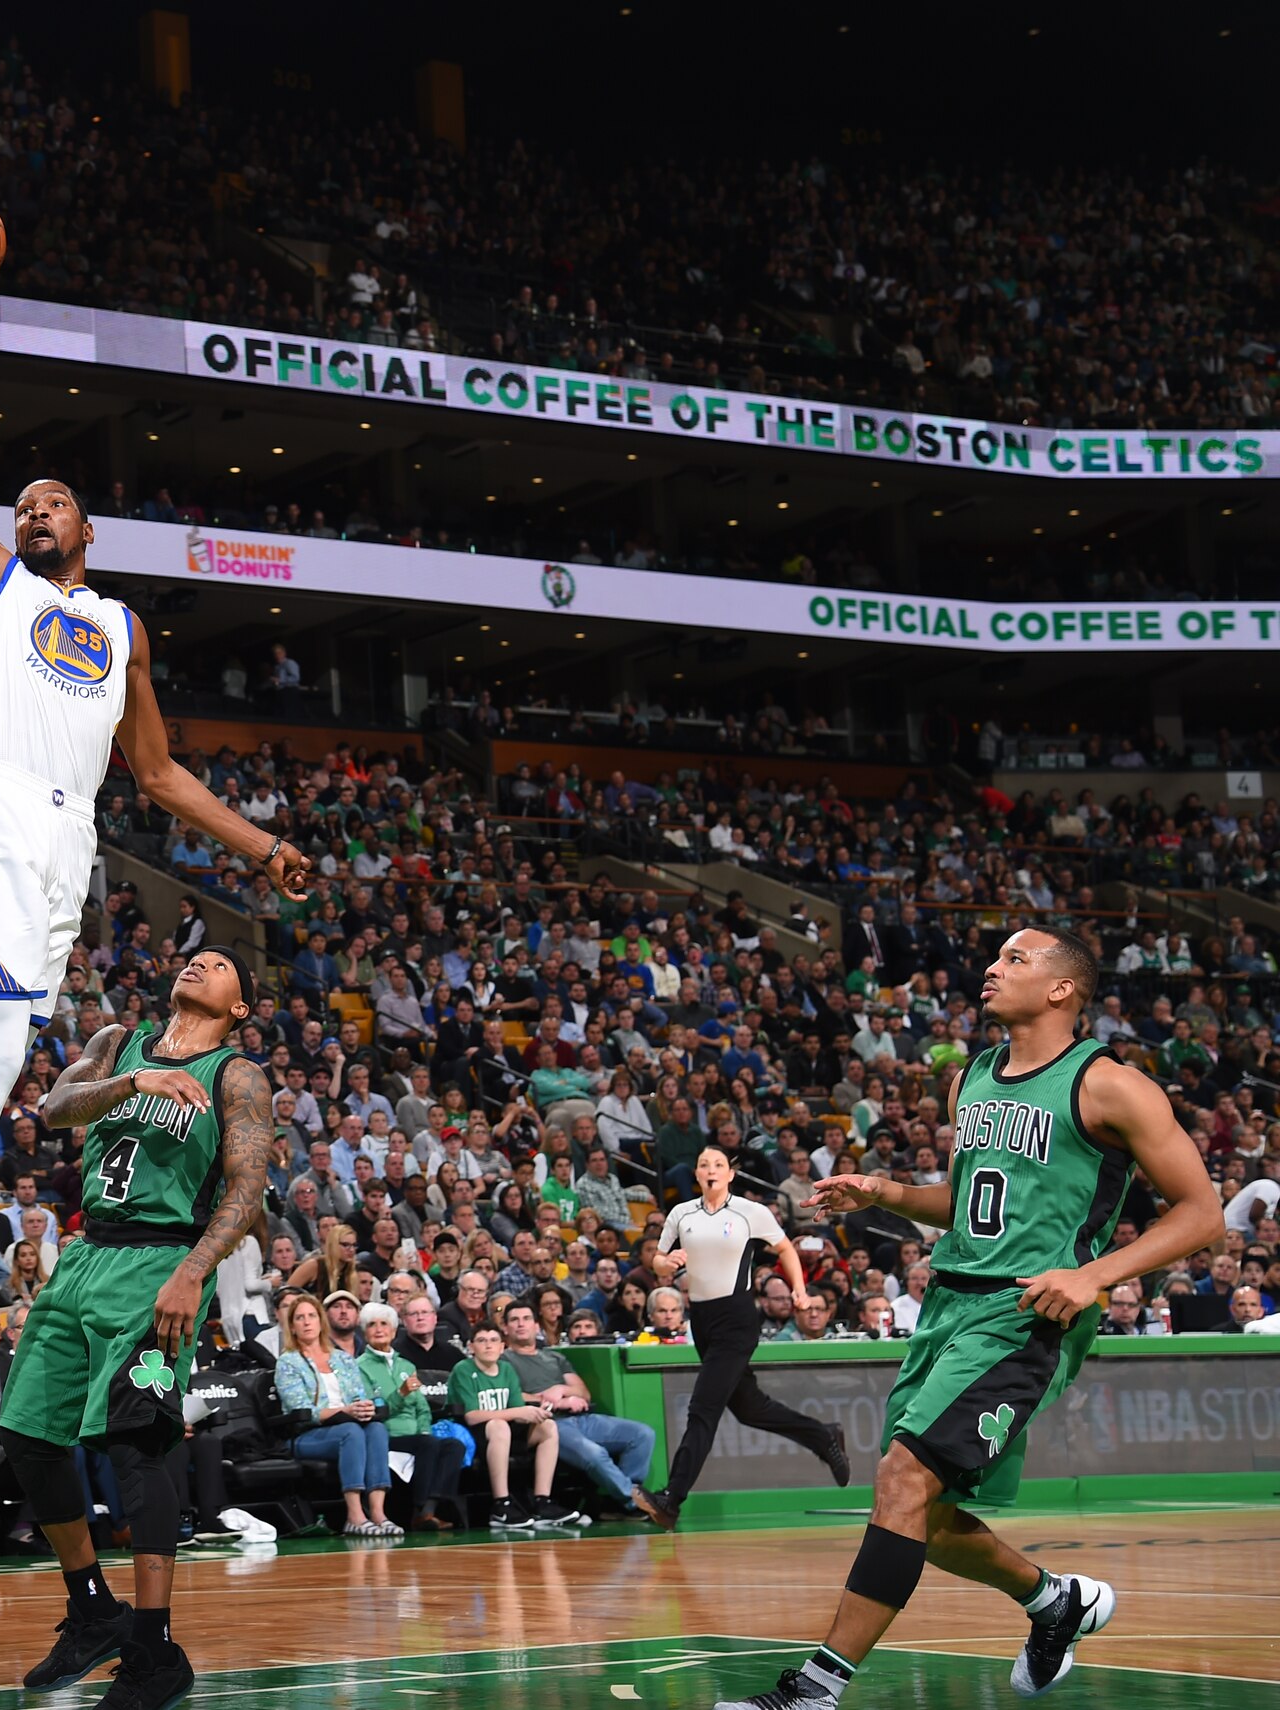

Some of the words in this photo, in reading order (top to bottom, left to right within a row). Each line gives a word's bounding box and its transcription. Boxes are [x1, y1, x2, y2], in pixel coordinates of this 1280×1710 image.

[203, 334, 447, 401] OFFICIAL
[464, 367, 653, 425] COFFEE
[671, 392, 729, 432] OF
[746, 402, 837, 447] THE
[853, 415, 1032, 468] BOSTON
[1047, 437, 1264, 474] CELTICS
[216, 540, 295, 562] DUNKIN'
[216, 558, 293, 581] DONUTS
[35, 598, 82, 615] GOLEN
[808, 596, 979, 639] OFFICIAL
[990, 611, 1162, 641] COFFEE
[1177, 611, 1235, 640] OF
[1250, 610, 1280, 639] T
[73, 627, 104, 652] 35
[26, 652, 107, 699] WARRIORS
[96, 1093, 197, 1143] OSTON
[954, 1100, 1053, 1165] BOSTON
[97, 1136, 140, 1203] 4
[968, 1167, 1008, 1239] 0
